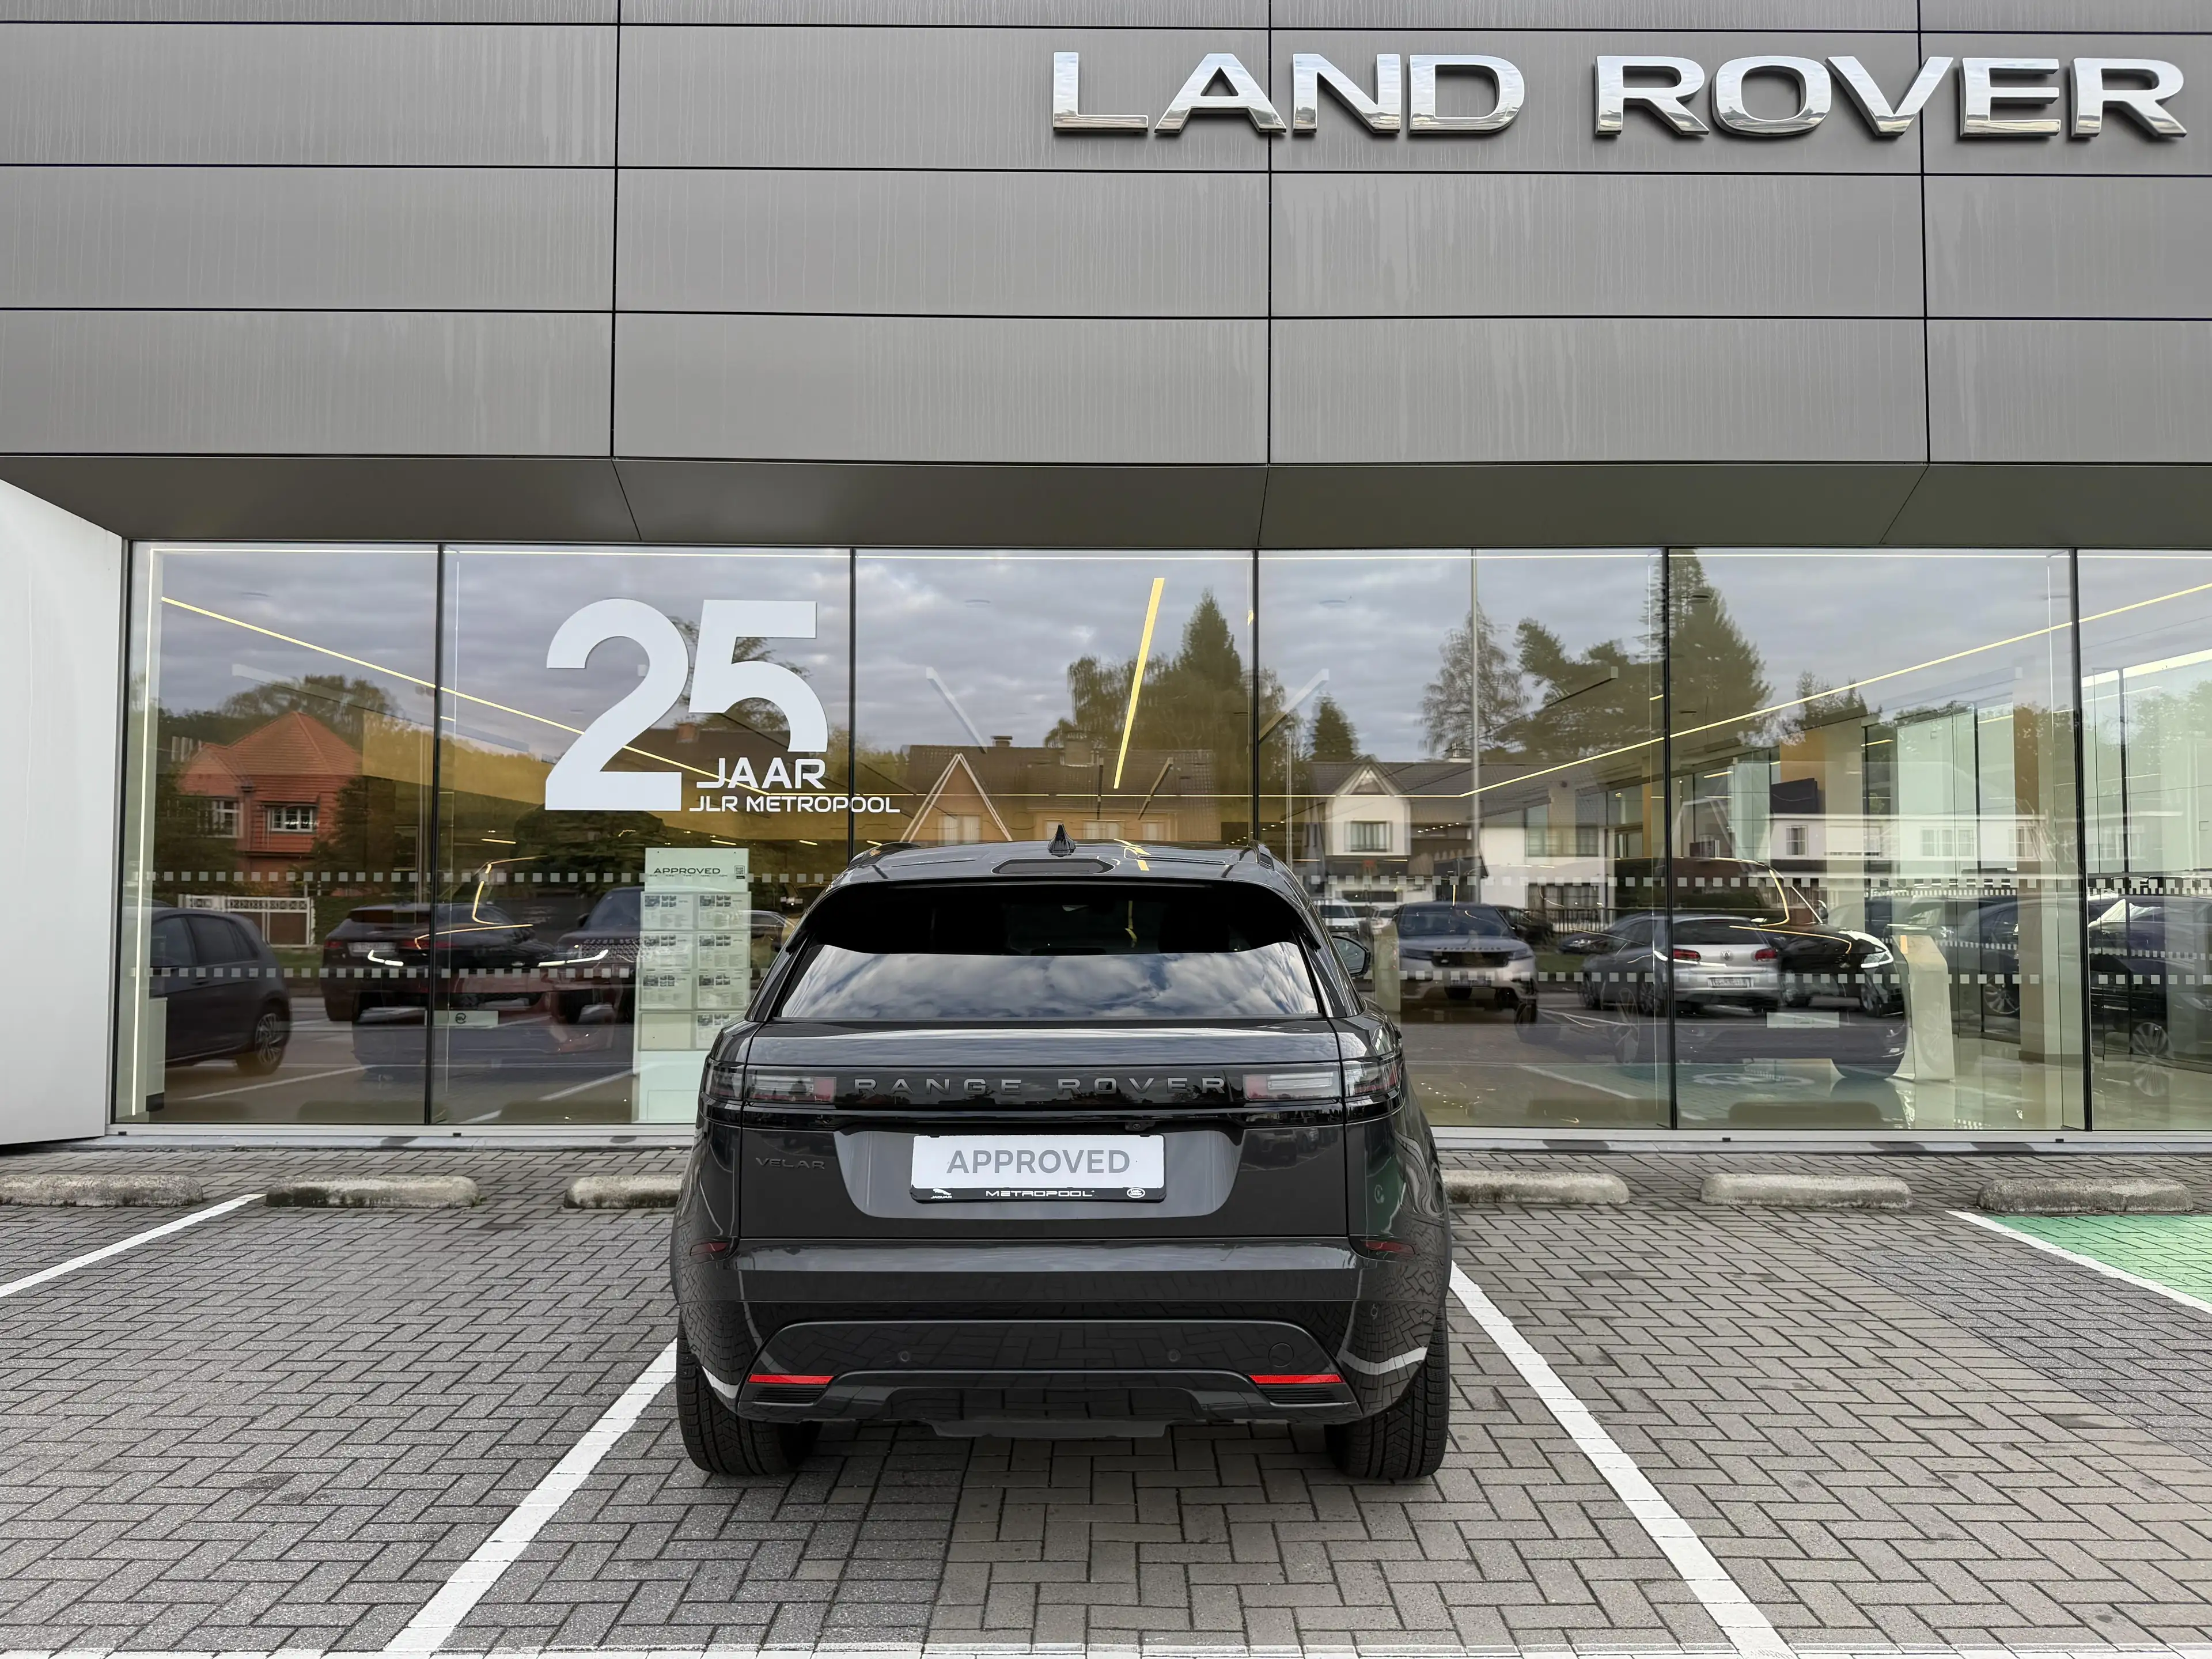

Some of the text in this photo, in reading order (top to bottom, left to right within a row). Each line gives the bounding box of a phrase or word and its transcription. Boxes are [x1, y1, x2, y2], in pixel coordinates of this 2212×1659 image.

[1051, 50, 2188, 139] LAND ROVER
[545, 598, 828, 812] 25
[696, 757, 826, 789] JAAR
[690, 796, 900, 813] JLR METROPOOL
[854, 1078, 1225, 1094] RANGE ROVER
[755, 1157, 825, 1170] VELAR
[946, 1149, 1130, 1174] APPROVED
